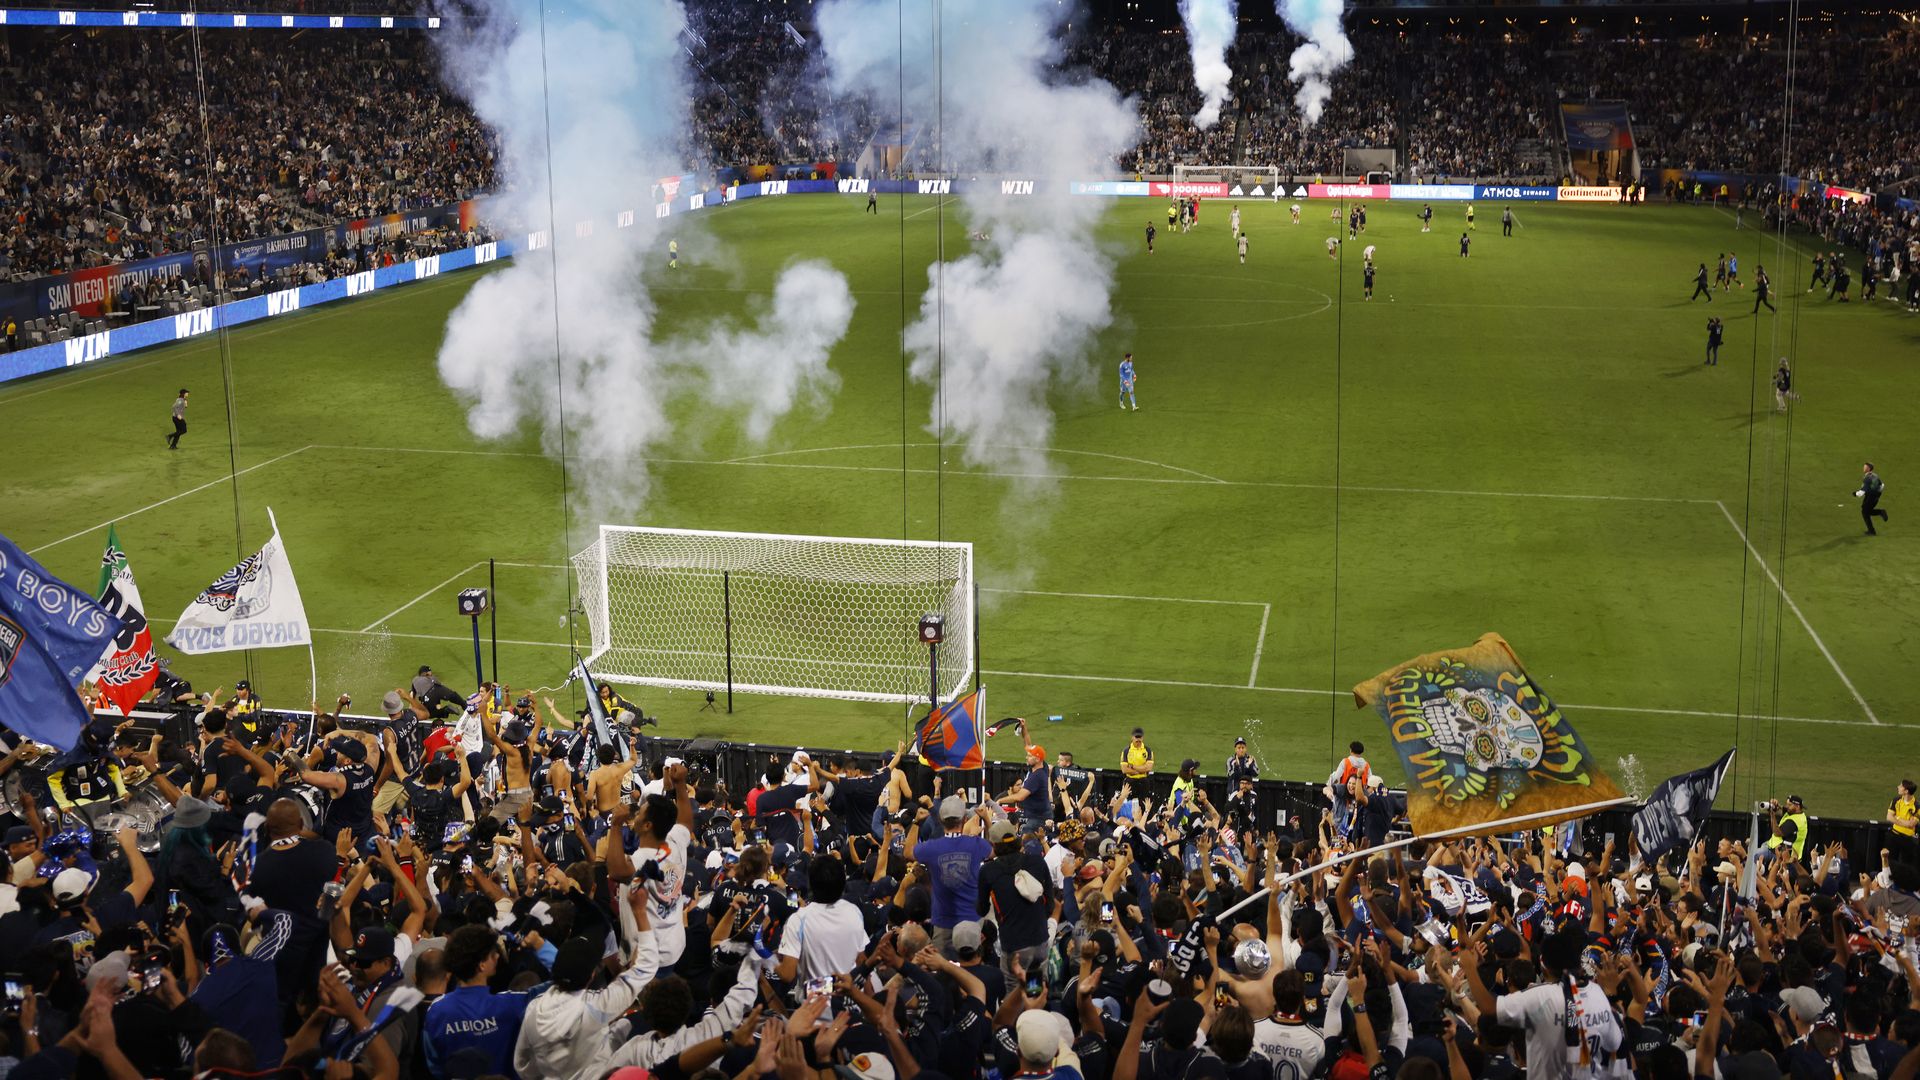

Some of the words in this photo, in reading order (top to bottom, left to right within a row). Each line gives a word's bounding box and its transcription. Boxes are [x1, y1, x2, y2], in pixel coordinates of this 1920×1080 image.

[58, 11, 76, 25] WIN
[122, 12, 139, 26] WIN
[180, 13, 196, 26] WIN
[761, 180, 788, 195] WIN
[838, 179, 869, 193] WIN
[918, 179, 951, 194] WIN
[1001, 180, 1034, 195] WIN
[1172, 184, 1221, 194] DOORDASH
[1394, 187, 1437, 196] DIRECTV
[1560, 187, 1612, 199] Continental
[656, 202, 670, 219] WIN
[690, 193, 704, 210] WIN
[617, 208, 634, 229] WIN
[266, 237, 290, 254] BASHOR
[290, 235, 308, 249] FIELD
[345, 230, 360, 250] SAN
[528, 231, 548, 251] WIN
[474, 241, 497, 265] WIN
[415, 254, 440, 280] WIN
[346, 269, 375, 297] WIN
[48, 285, 72, 311] SAN
[74, 276, 105, 306] DIEGO
[267, 287, 300, 316] WIN
[175, 308, 213, 340] WIN
[64, 330, 111, 367] WIN
[16, 568, 108, 638] BOYS
[0, 623, 18, 649] EGO
[1059, 768, 1068, 776] SAN
[1068, 769, 1080, 778] DIEGO
[1080, 771, 1086, 779] FC
[445, 1016, 498, 1035] ALBION
[1260, 1042, 1303, 1059] DREYER
